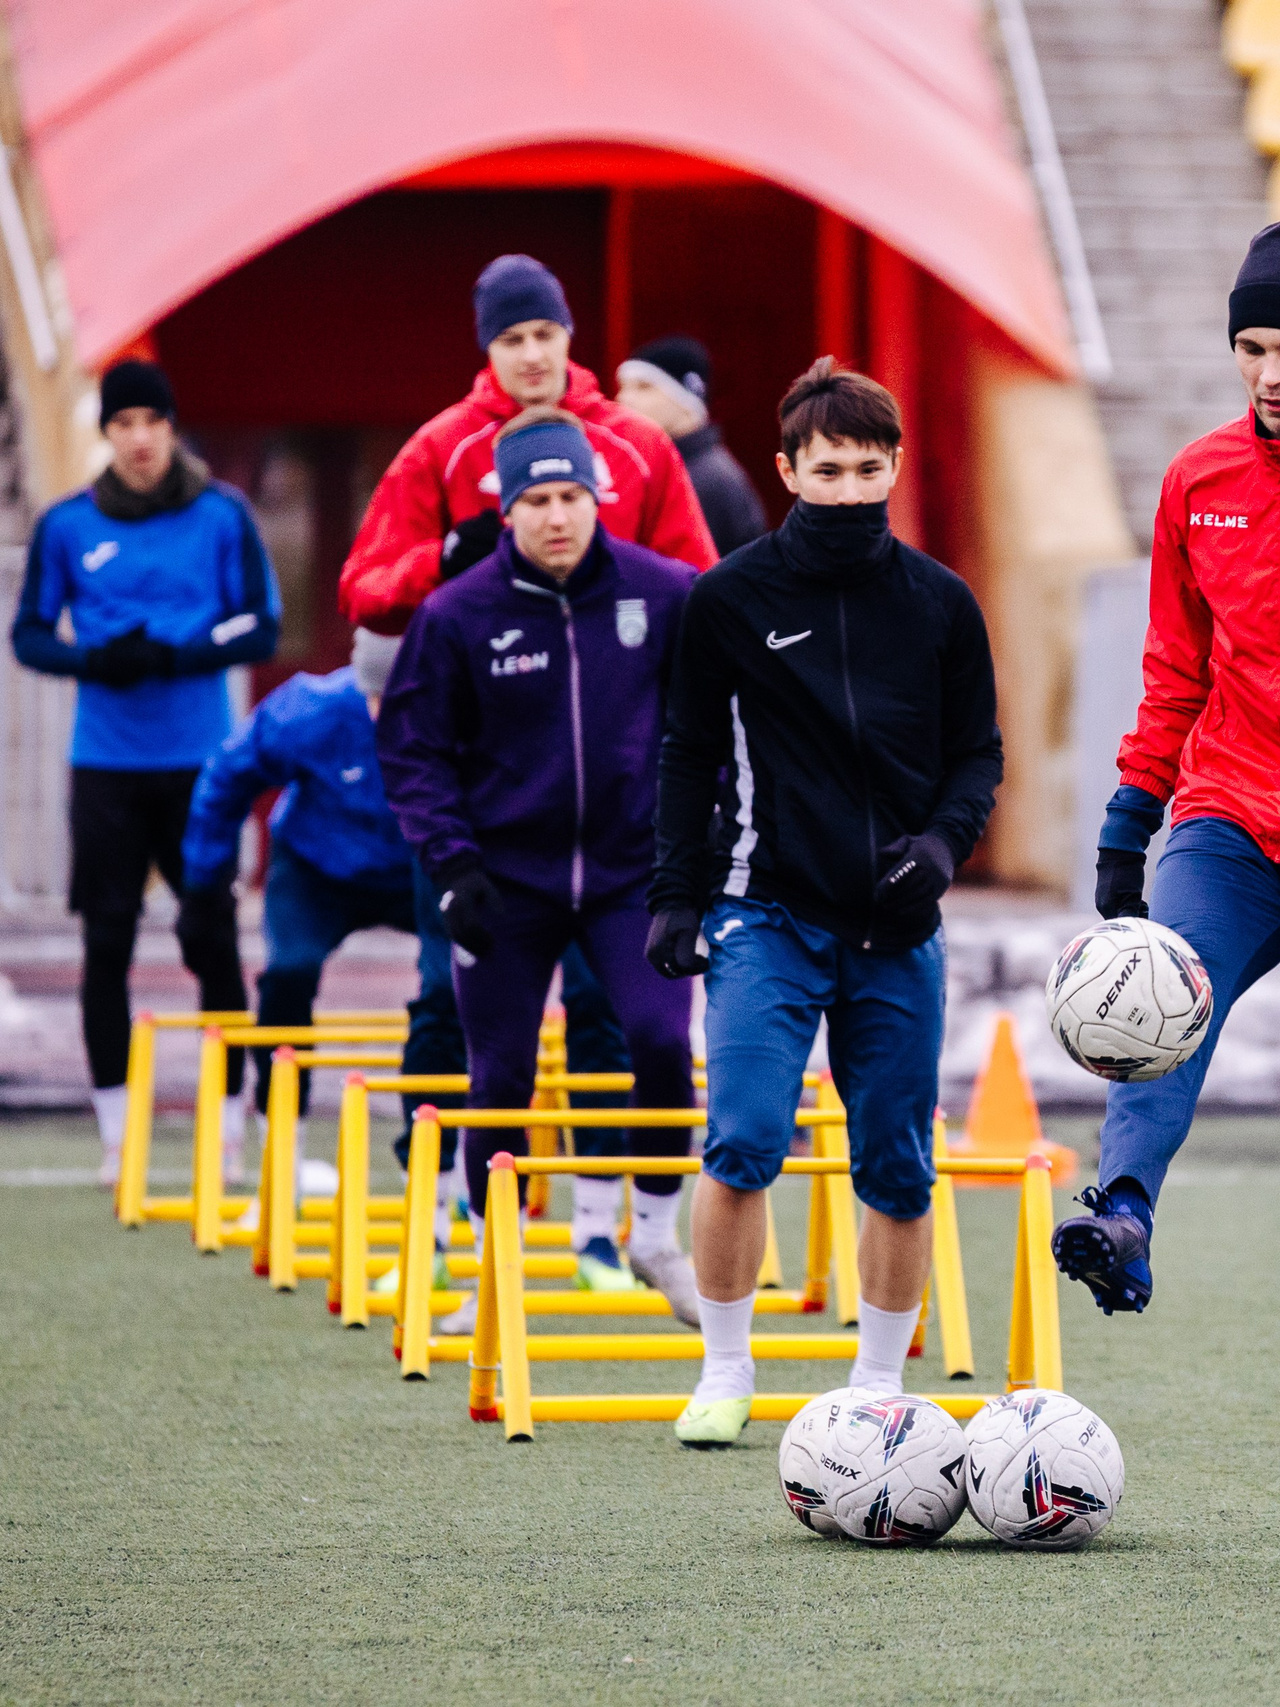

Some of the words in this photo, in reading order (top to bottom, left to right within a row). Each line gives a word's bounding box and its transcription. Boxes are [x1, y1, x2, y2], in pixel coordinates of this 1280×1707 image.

[1190, 512, 1249, 529] KELME
[490, 651, 549, 677] LEON
[1096, 952, 1142, 1021] DEMIX
[820, 1452, 862, 1480] DEMIX
